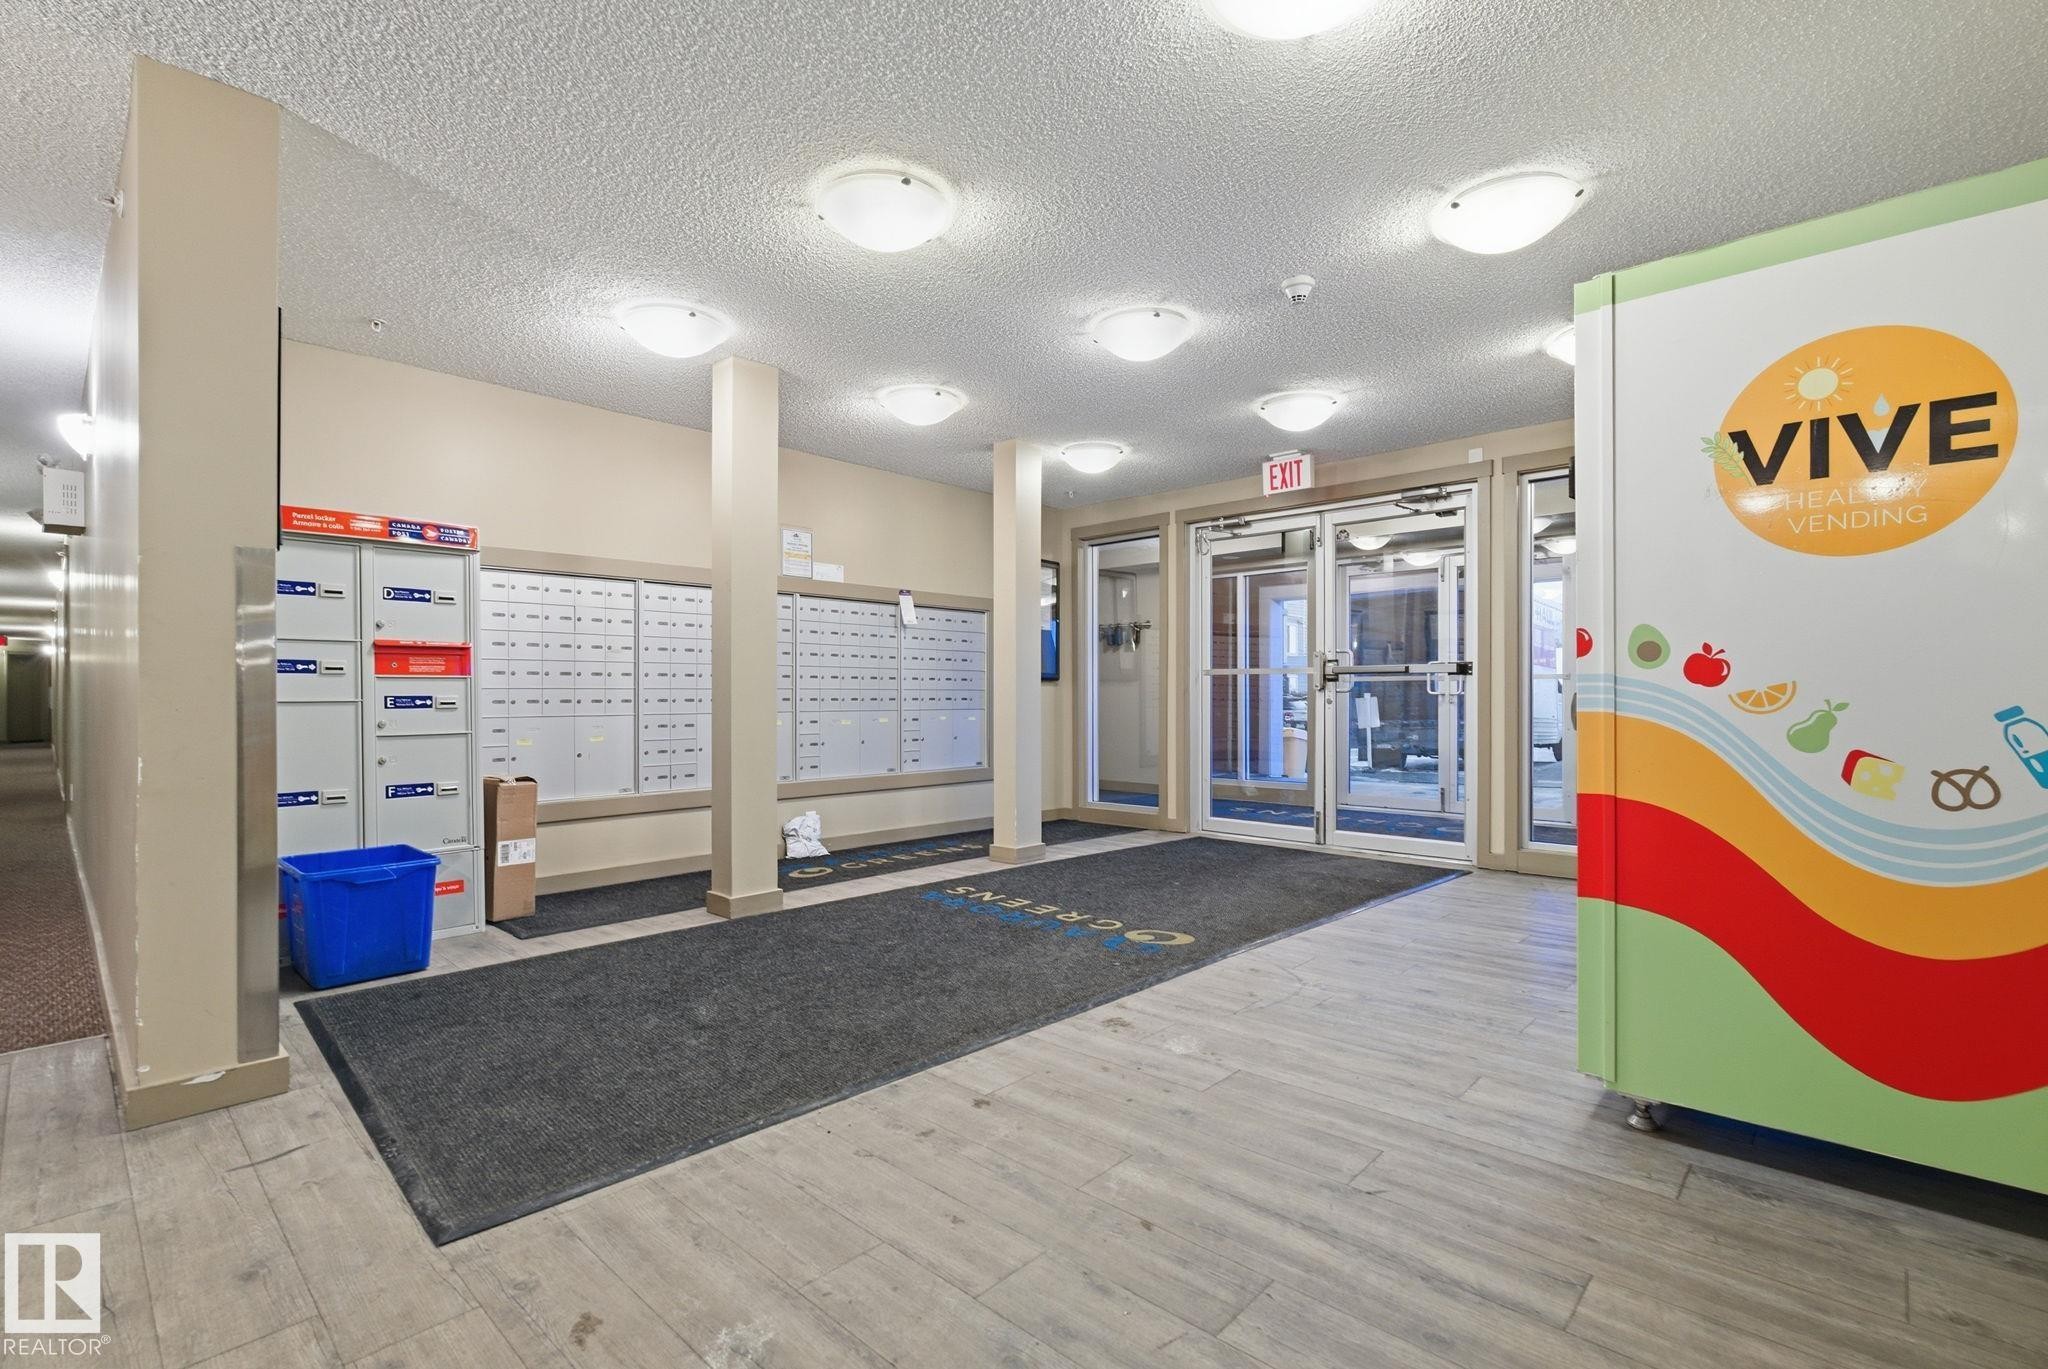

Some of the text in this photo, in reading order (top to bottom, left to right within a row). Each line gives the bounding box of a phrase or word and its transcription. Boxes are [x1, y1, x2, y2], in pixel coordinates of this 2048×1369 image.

[1728, 391, 1999, 486] VIVE
[1270, 459, 1303, 491] EXIT
[292, 511, 336, 522] Parcel locker
[1788, 505, 1927, 534] VENDING
[391, 522, 421, 530] CANADA
[384, 588, 395, 599] D
[386, 697, 395, 708] E
[388, 786, 396, 798] F
[945, 885, 1124, 931] GREENS
